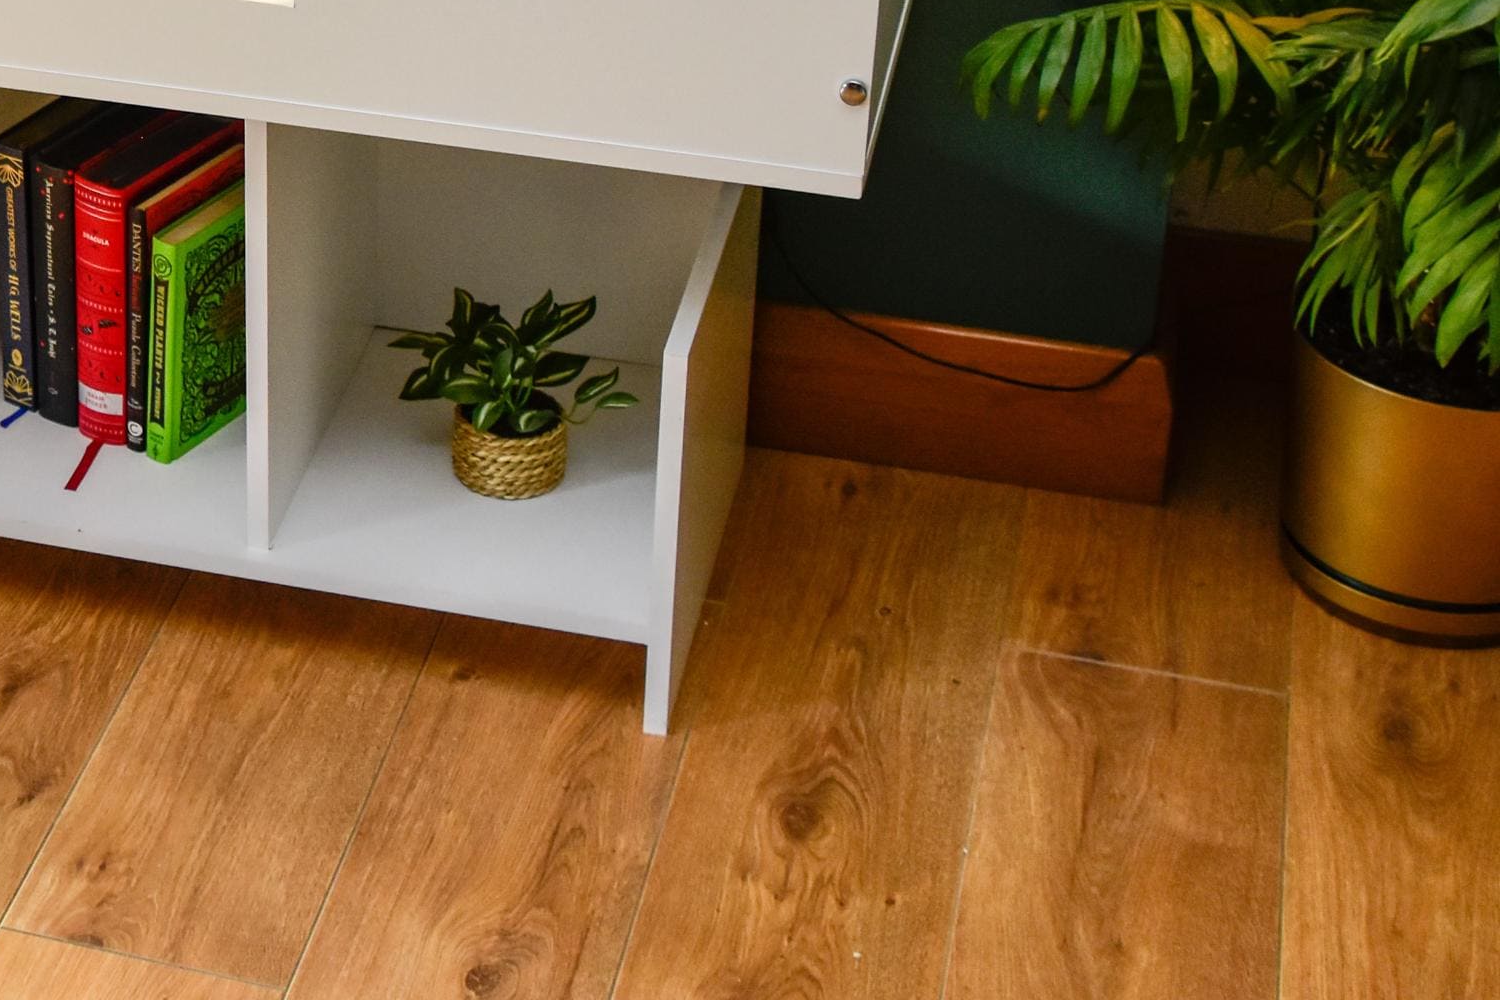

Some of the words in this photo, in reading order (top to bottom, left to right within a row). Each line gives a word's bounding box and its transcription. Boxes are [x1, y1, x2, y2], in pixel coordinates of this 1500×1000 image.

[6, 186, 15, 226] GREATEST
[8, 227, 17, 258] WORKS
[82, 231, 109, 247] DRACULA
[9, 259, 18, 272] OF
[10, 299, 22, 341] WELLS
[156, 285, 165, 326] WICKED
[155, 327, 164, 369] PLANTS
